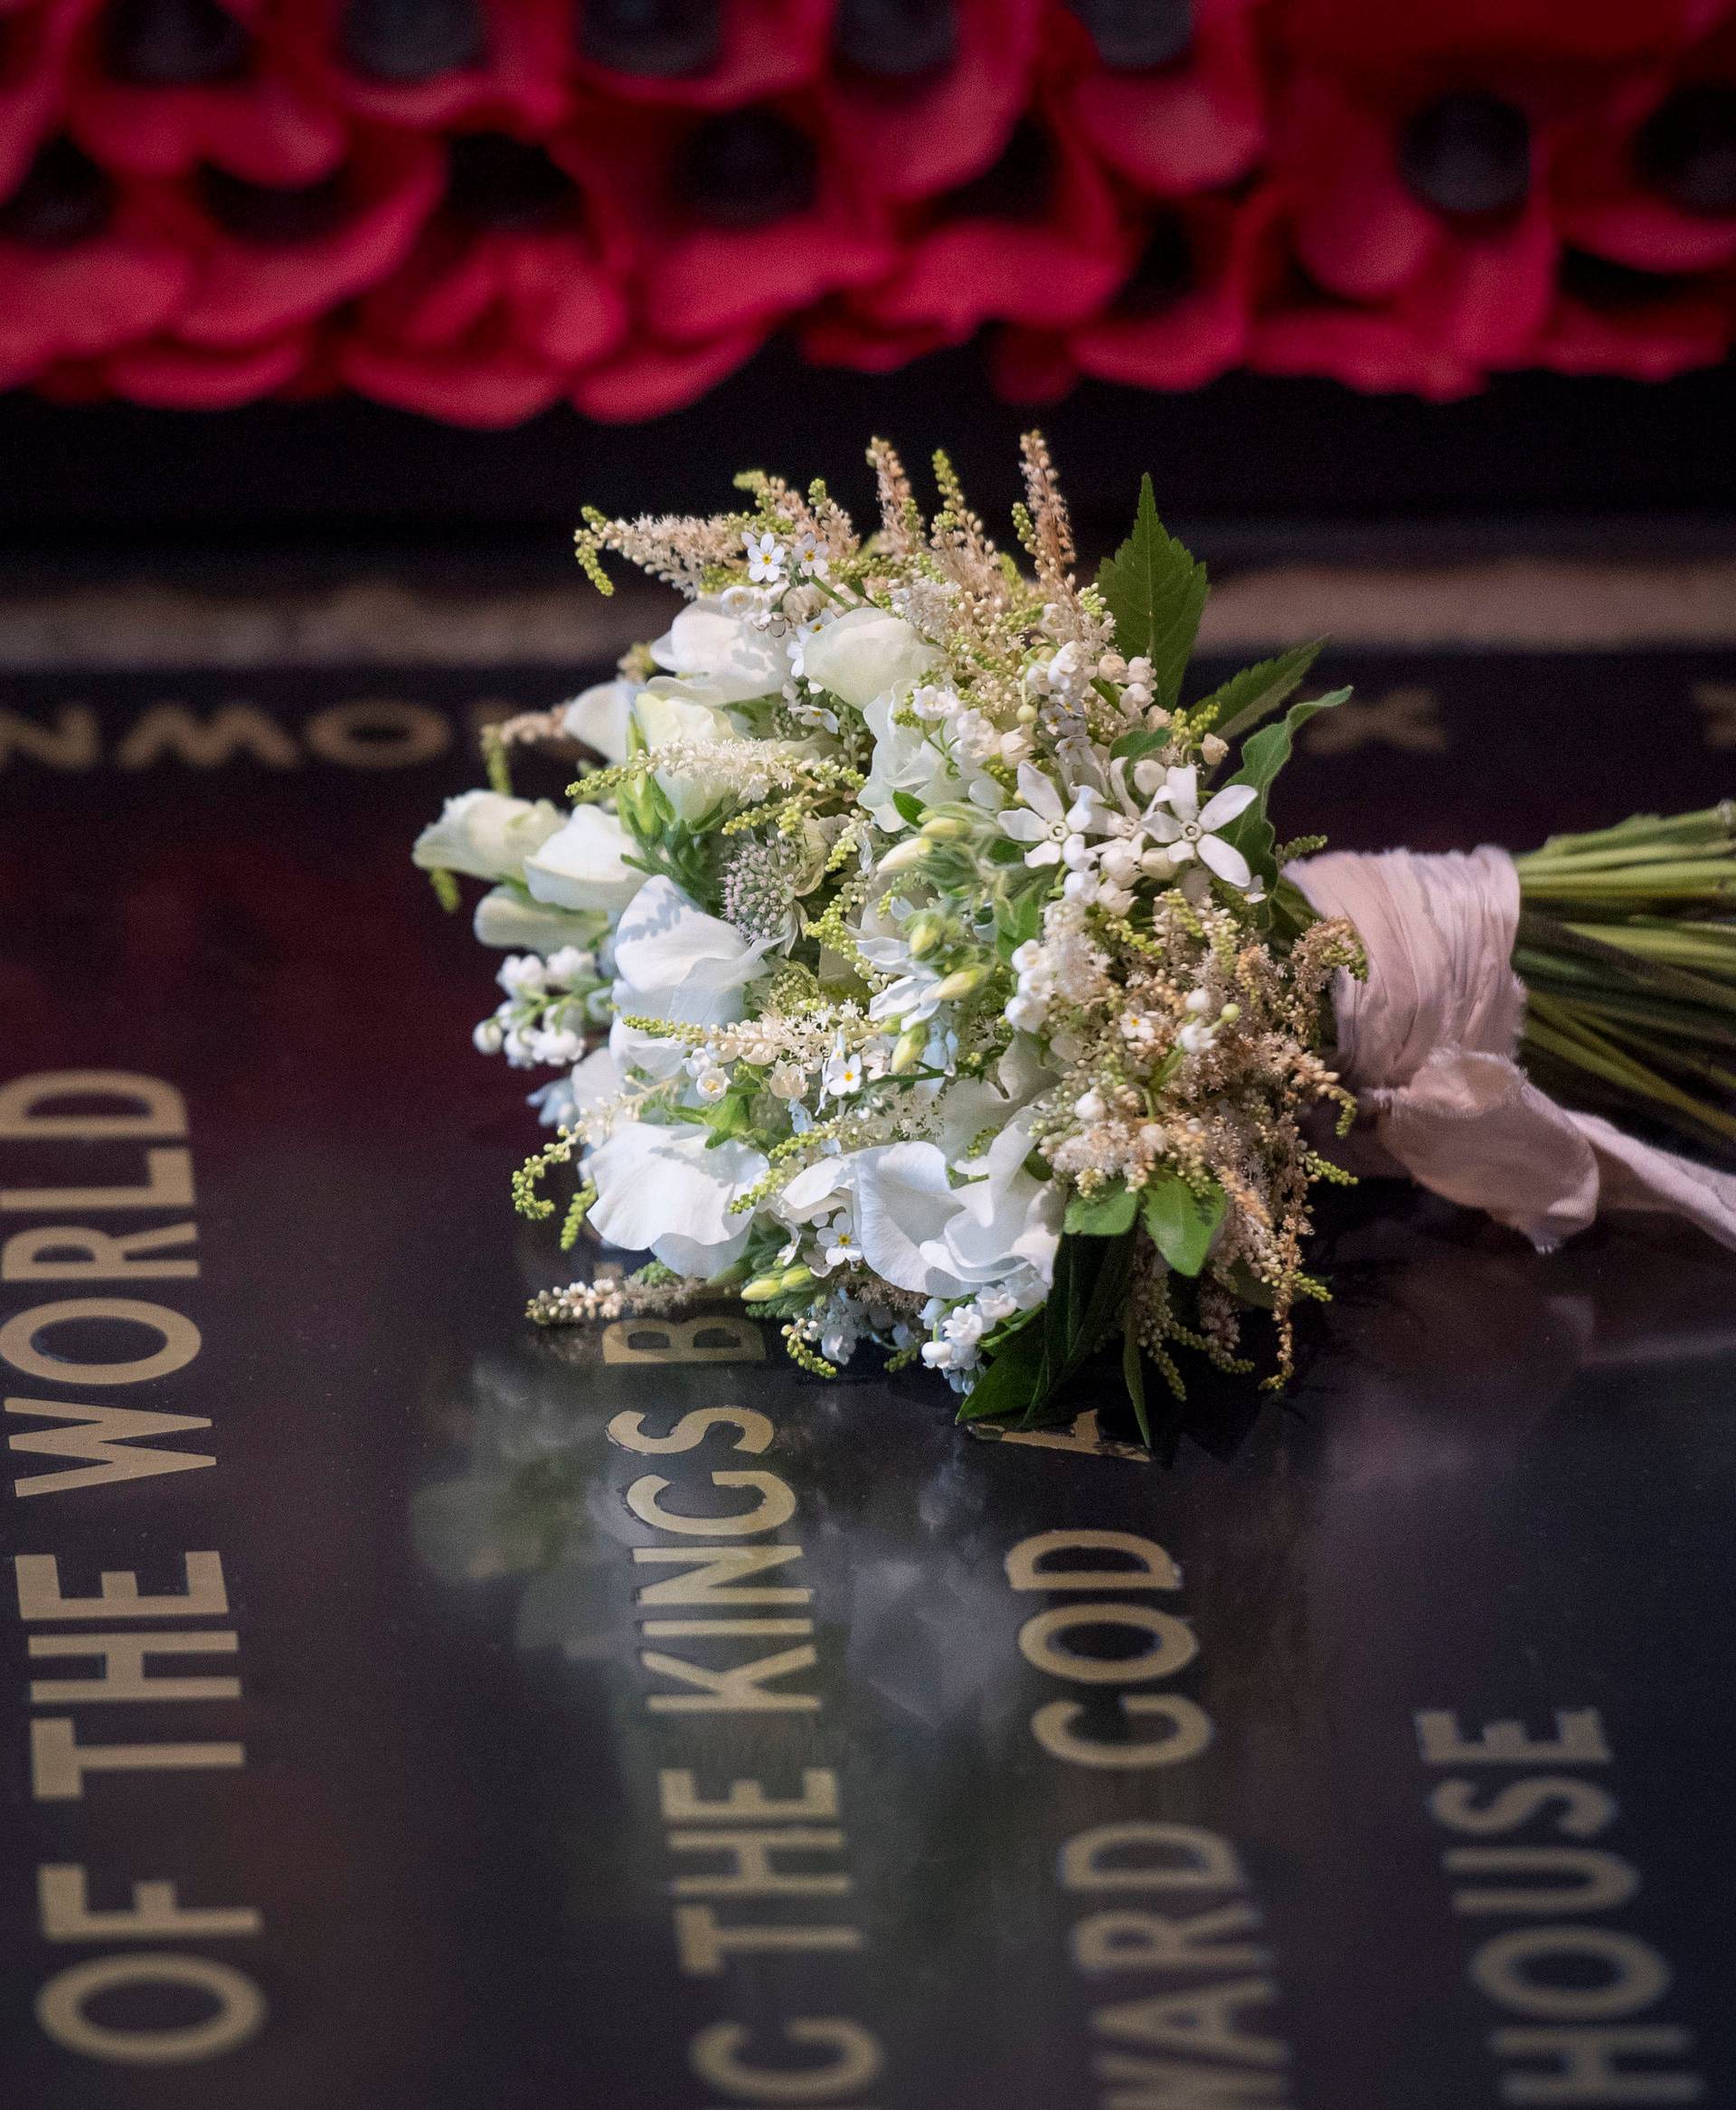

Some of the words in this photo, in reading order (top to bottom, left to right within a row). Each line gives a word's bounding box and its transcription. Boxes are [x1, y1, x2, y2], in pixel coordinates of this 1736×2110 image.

[0, 1071, 218, 1498] WORLD
[14, 1547, 246, 1798] THE
[604, 1405, 821, 1715] KINGS
[1005, 1528, 1215, 1770] GOD
[36, 1863, 266, 2064] OF
[656, 1765, 863, 1971] THE
[1410, 1705, 1703, 2105] HOUSE
